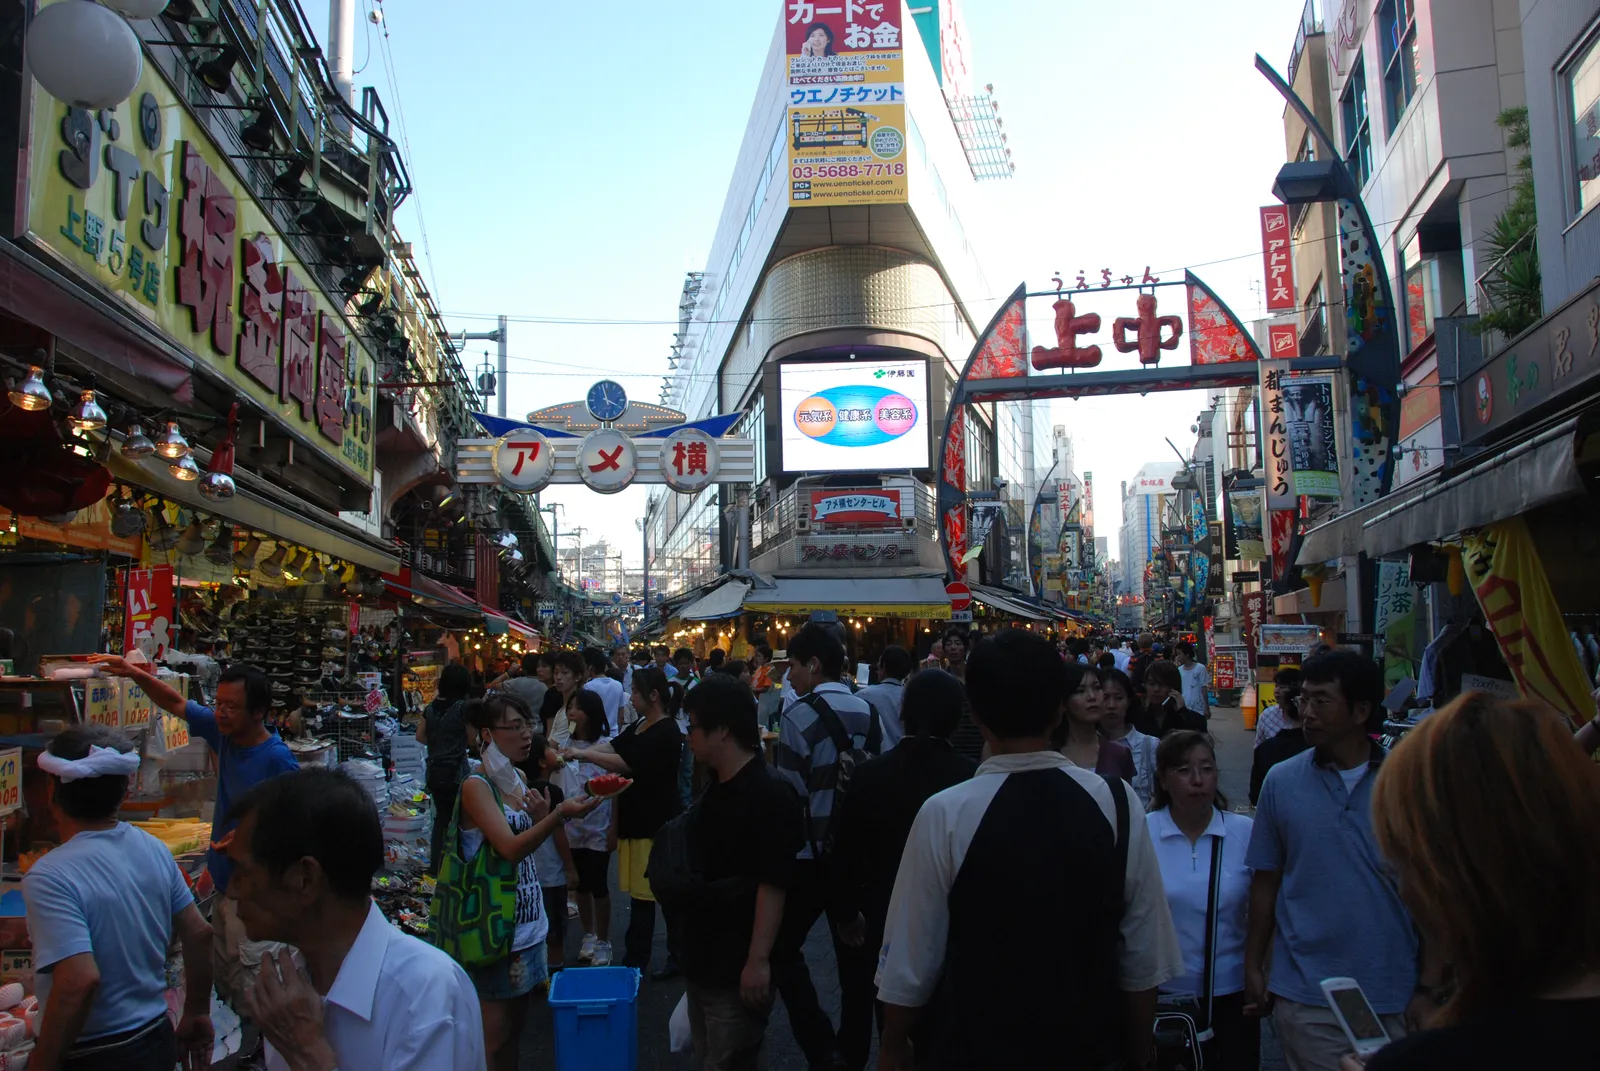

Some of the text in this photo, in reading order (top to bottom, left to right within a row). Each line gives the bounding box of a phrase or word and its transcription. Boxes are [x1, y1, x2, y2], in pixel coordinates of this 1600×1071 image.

[788, 0, 884, 24] カードで
[844, 22, 900, 48] お金
[790, 85, 903, 104] ウエノチケット
[792, 163, 905, 179] 03-5688-7718
[813, 180, 893, 188] www.uenoticket.com
[60, 194, 161, 306] 上野5号店
[1051, 266, 1160, 291] うえちゅん
[1268, 239, 1289, 302] アドアーズ
[175, 139, 346, 446] 現金問屋
[1031, 293, 1183, 372] 上中
[887, 369, 915, 378] 伊藤園
[799, 408, 912, 423] 元気系 健康系 美容系
[1264, 370, 1290, 497] 都まんじゅう
[506, 441, 708, 477] アメ横
[825, 496, 887, 510] アメ横センタービル
[802, 543, 914, 561] アメ横センター
